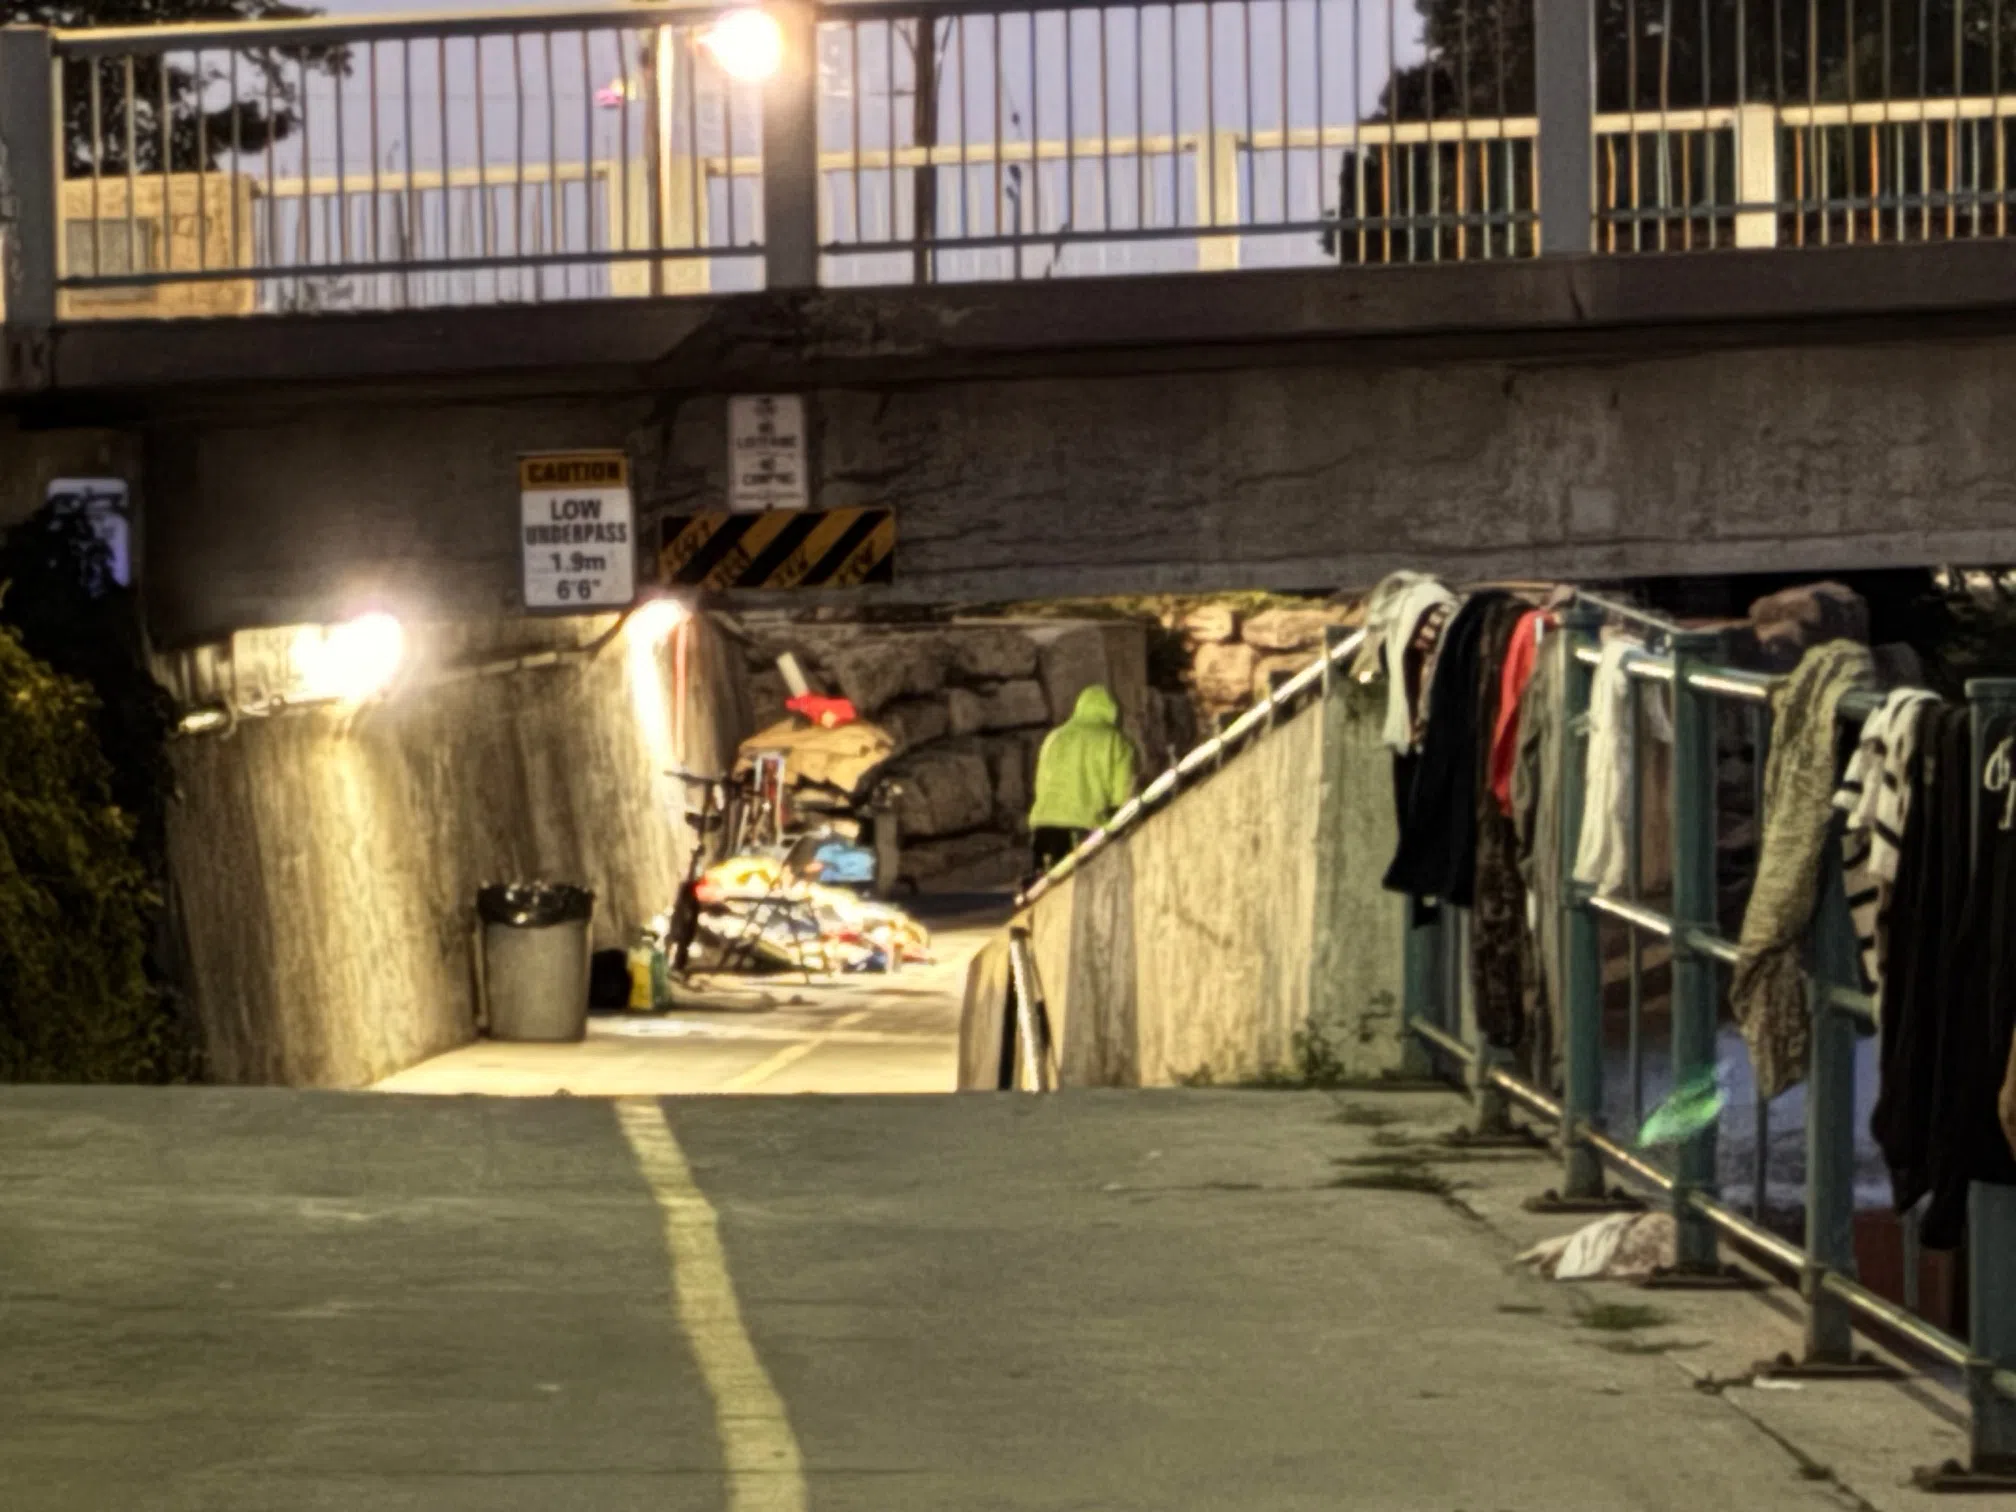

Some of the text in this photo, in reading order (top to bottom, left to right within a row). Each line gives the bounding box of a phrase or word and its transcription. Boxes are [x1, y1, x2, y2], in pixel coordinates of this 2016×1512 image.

[528, 461, 621, 483] CAUTION
[551, 499, 601, 521] LOW
[525, 522, 627, 545] UNDERPASS
